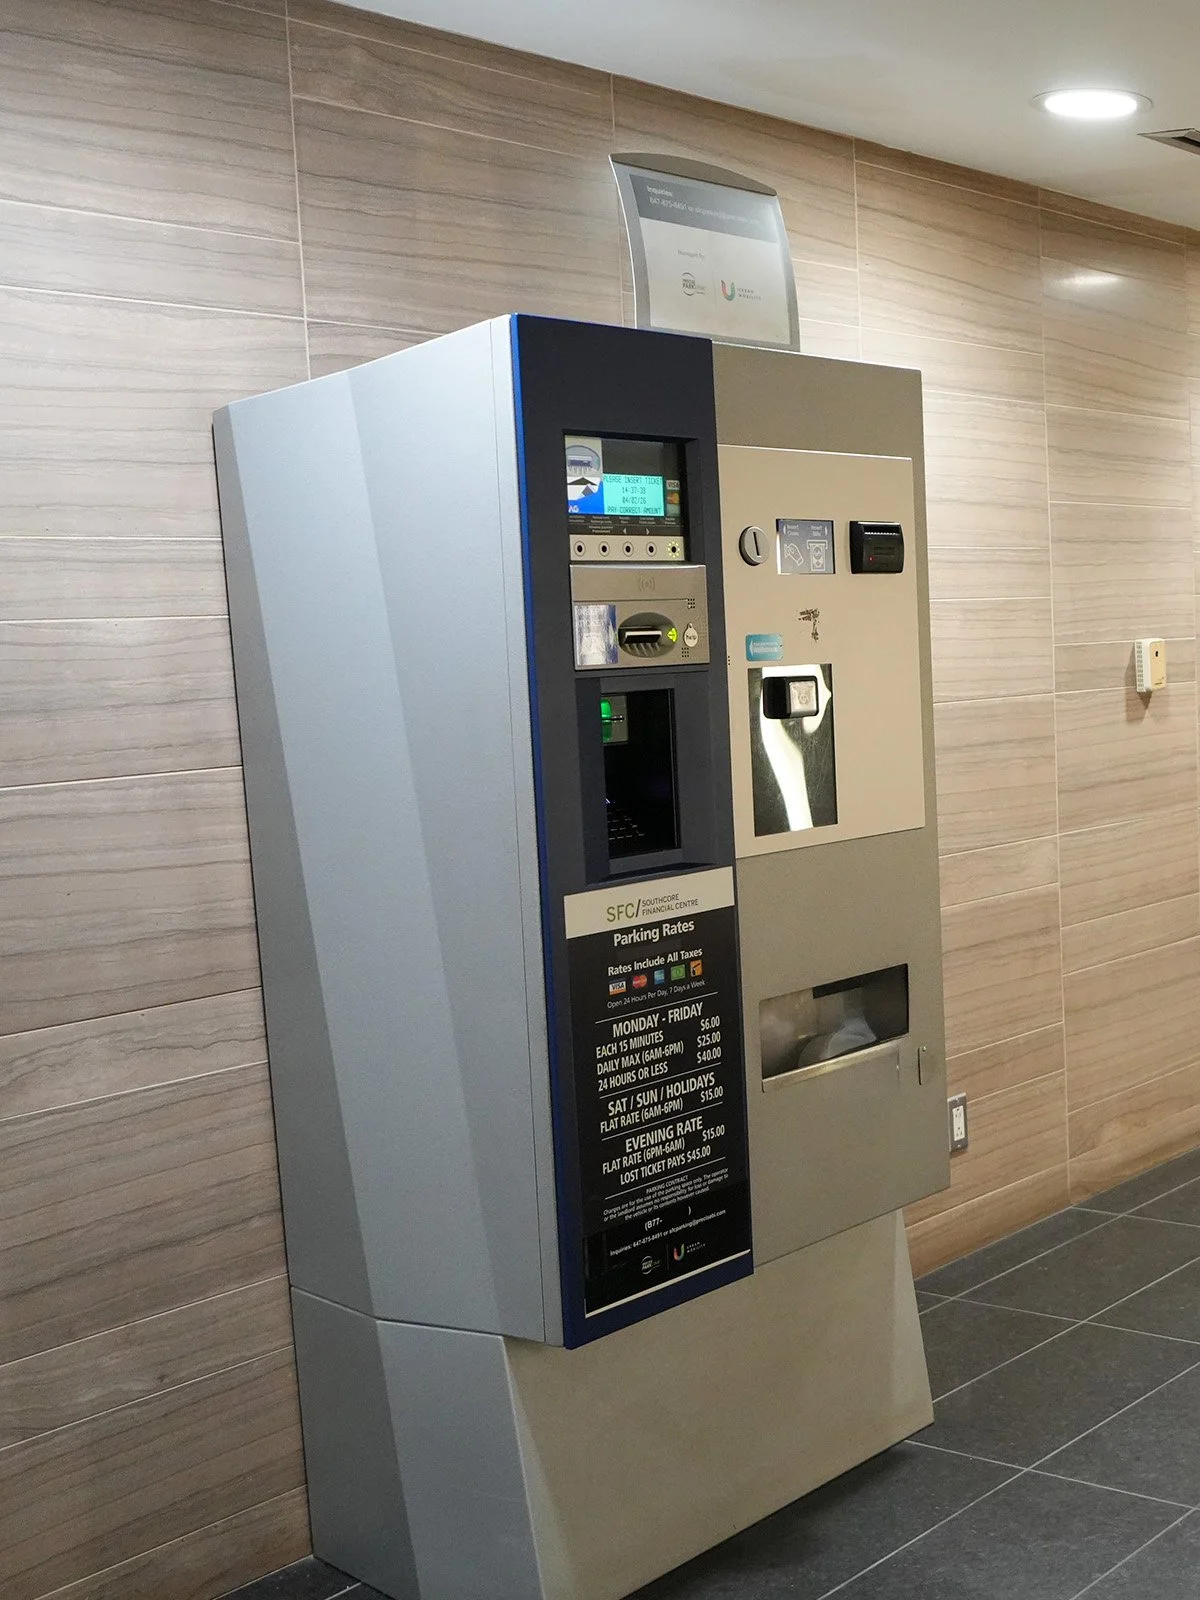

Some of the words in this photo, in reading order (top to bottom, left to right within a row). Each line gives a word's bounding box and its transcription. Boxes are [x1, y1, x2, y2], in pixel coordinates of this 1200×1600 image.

[642, 894, 680, 907] SOUTHCORE
[642, 904, 674, 916] FINANCIAL
[675, 899, 698, 910] CENTRE
[614, 928, 660, 946] Parking
[662, 920, 695, 936] Rates
[608, 964, 632, 976] Rates
[634, 956, 665, 970] Include
[667, 952, 678, 964] All
[680, 948, 703, 960] Taxes
[607, 1000, 622, 1008] Open
[631, 994, 647, 1002] Hours
[612, 1013, 660, 1038] MONDAY
[668, 1002, 703, 1024] FRIDAY
[596, 1042, 618, 1058] EACH
[620, 1040, 628, 1052] 15
[630, 1030, 664, 1050] MINUTES
[700, 1016, 720, 1031] $6.00
[597, 1058, 620, 1075] DAILY
[622, 1052, 640, 1068] MAX
[642, 1040, 684, 1064] (6AM-6PM)
[696, 1031, 720, 1048] $25.00
[598, 1078, 608, 1092] 24
[610, 1070, 636, 1087] HOURS
[638, 1066, 650, 1080] OR
[651, 1061, 668, 1076] LESS
[696, 1046, 722, 1064] $40.00
[600, 1118, 618, 1134] FLAT
[620, 1111, 640, 1127] RATE
[641, 1098, 684, 1122] (6AM-6PM)
[700, 1086, 724, 1102] $15.00
[608, 1098, 628, 1116] SAT
[636, 1088, 658, 1108] SUN
[666, 1072, 715, 1098] HOLIDAYS
[602, 1158, 620, 1174] FLAT
[622, 1152, 642, 1168] RATE
[643, 1137, 685, 1162] (6PM-6AM)
[702, 1124, 725, 1142] $15.00
[626, 1125, 674, 1153] EVENING
[676, 1116, 703, 1136] RATE
[620, 1168, 639, 1186] LOST
[641, 1160, 666, 1178] TICKET
[668, 1154, 686, 1169] PAYS
[686, 1145, 711, 1162] $45.00
